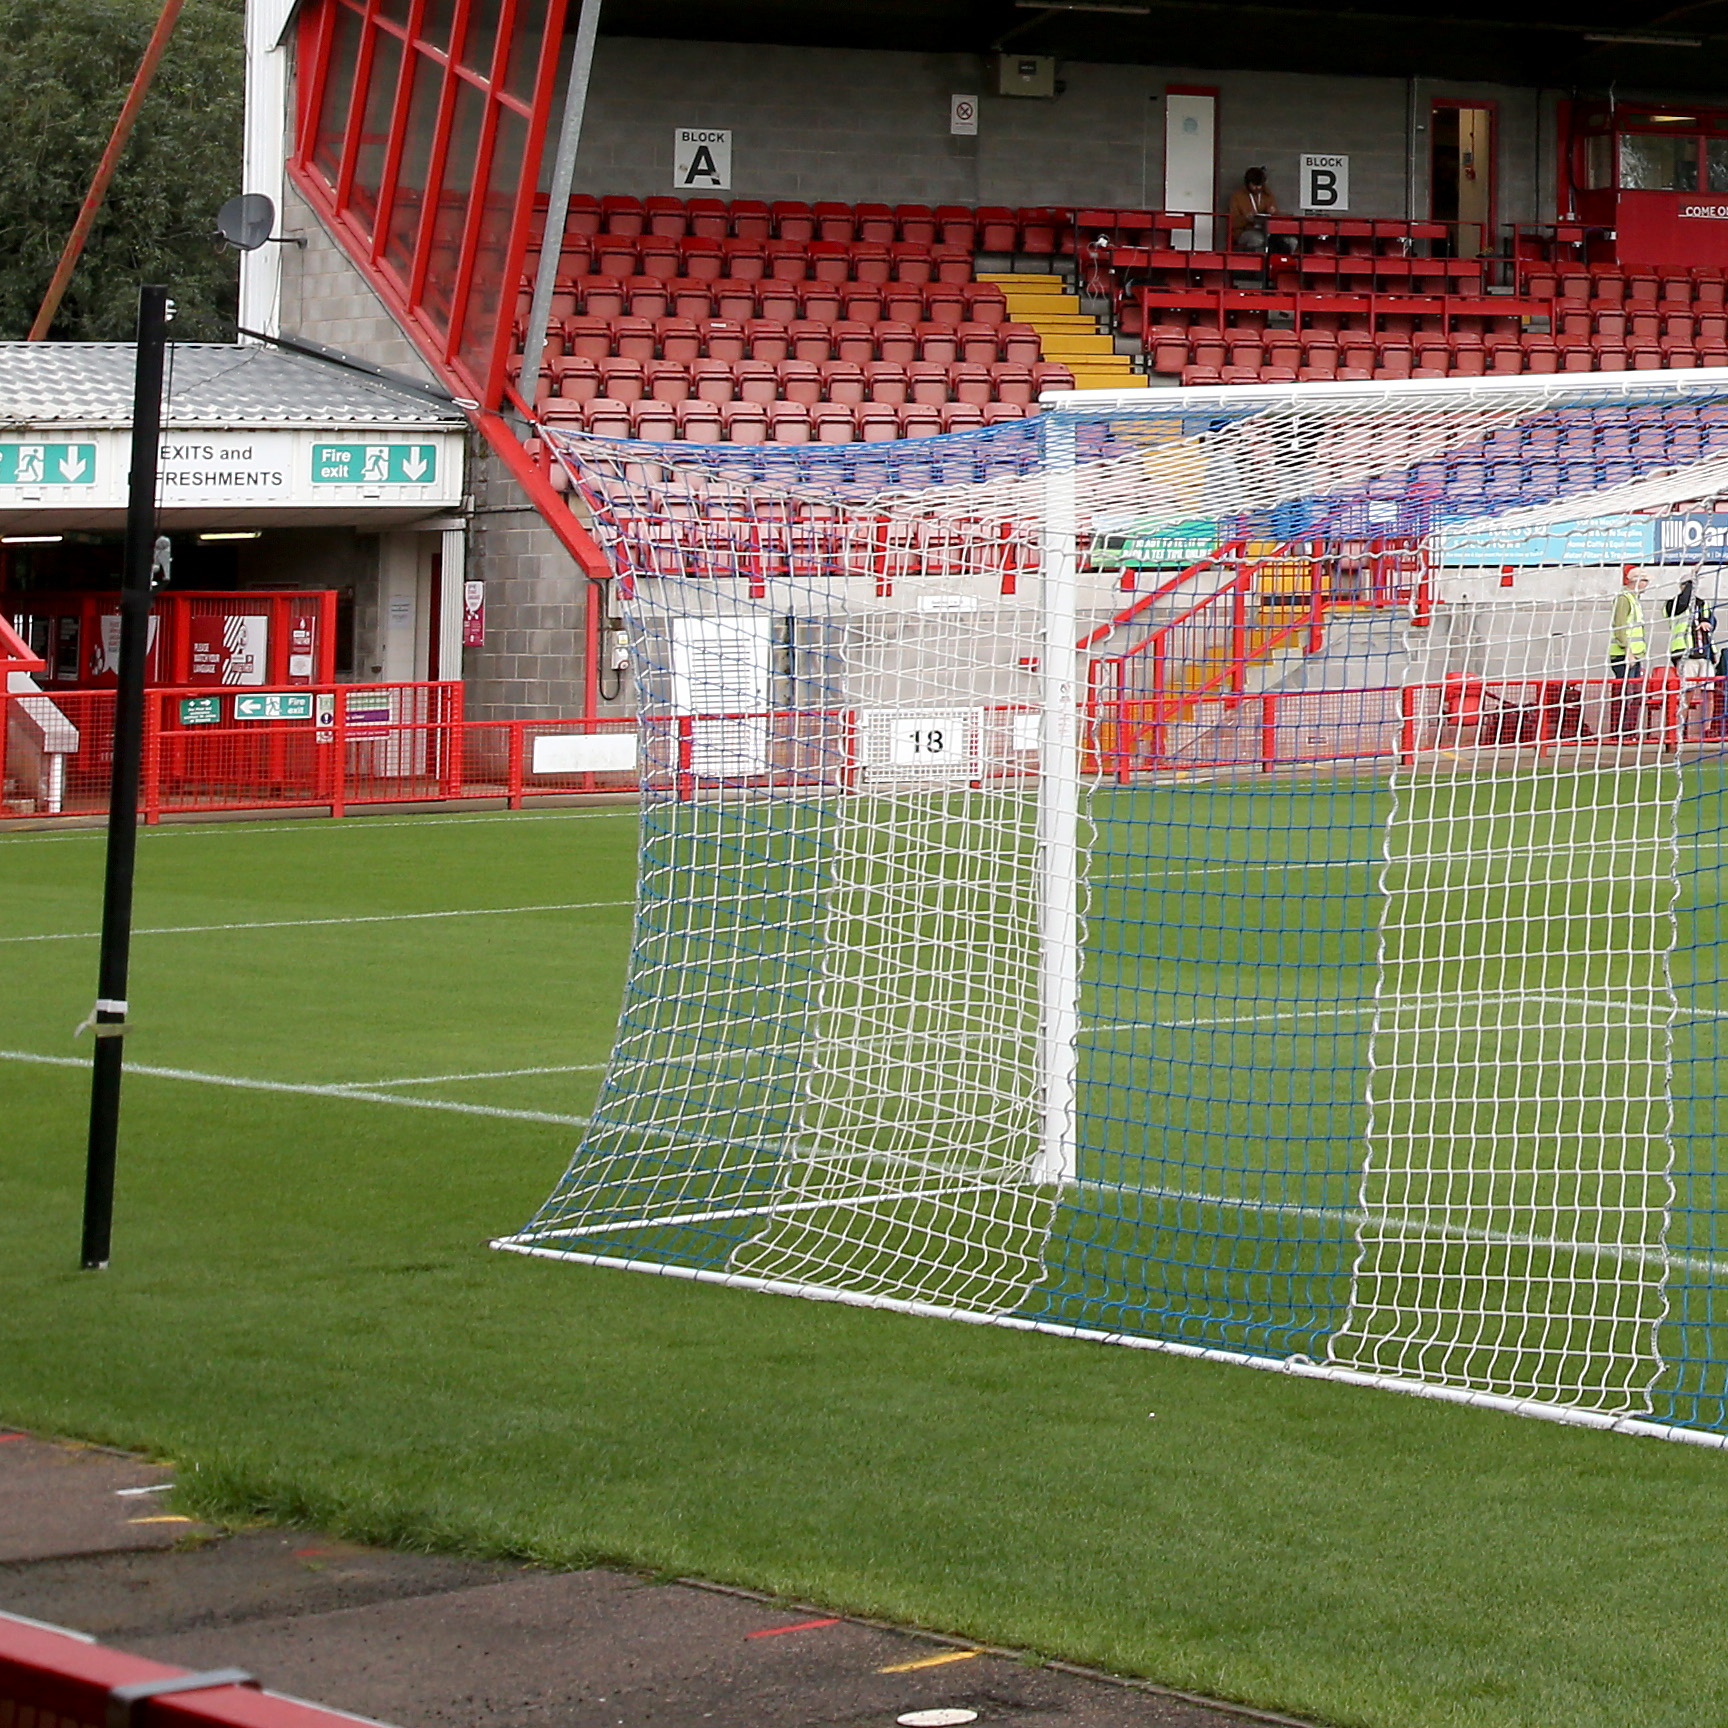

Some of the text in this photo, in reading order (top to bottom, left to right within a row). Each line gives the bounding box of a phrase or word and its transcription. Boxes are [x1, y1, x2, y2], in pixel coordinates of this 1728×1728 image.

[682, 132, 725, 143] BLOCK
[684, 145, 721, 185] A
[1306, 157, 1343, 167] BLOCK
[1311, 169, 1338, 206] B
[1685, 206, 1716, 216] COME
[160, 445, 252, 460] EXITS and
[321, 448, 352, 462] Fire
[153, 471, 283, 486] FRESHMENTS
[321, 464, 349, 479] exit
[288, 698, 306, 706] Fire
[287, 706, 304, 714] exit
[909, 729, 944, 754] 18
